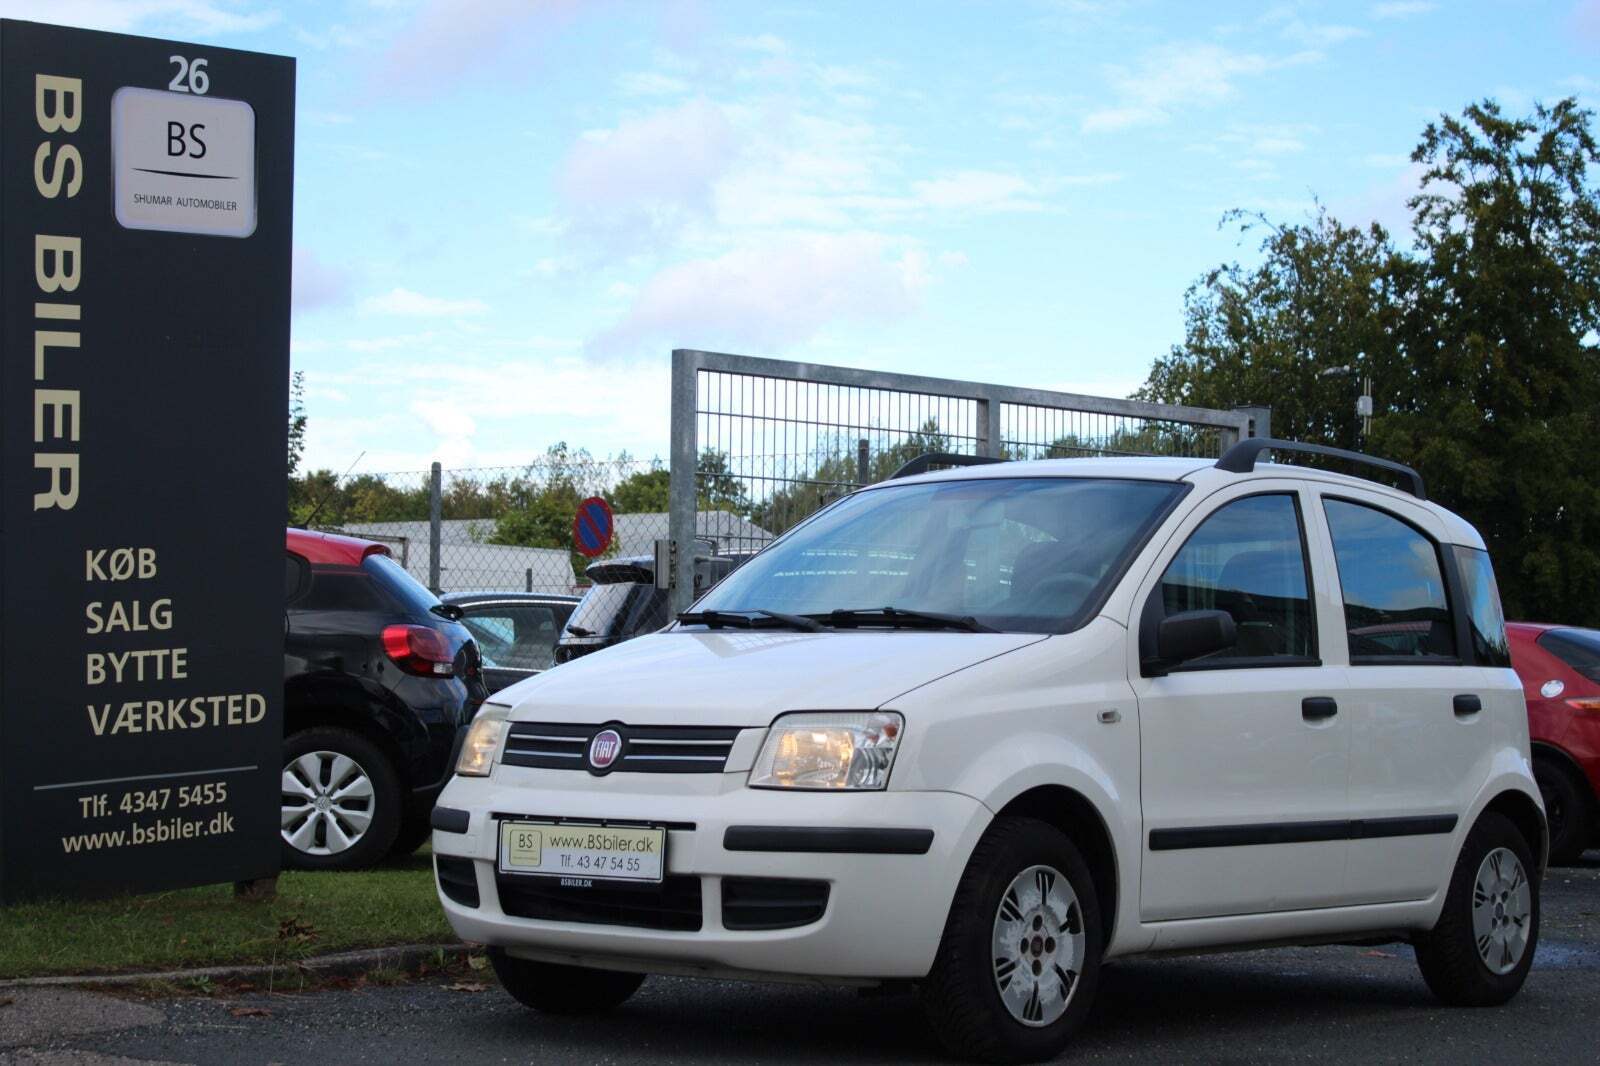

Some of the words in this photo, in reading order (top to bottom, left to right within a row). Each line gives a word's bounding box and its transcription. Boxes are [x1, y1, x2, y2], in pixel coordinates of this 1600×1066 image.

[168, 55, 210, 95] 26
[34, 73, 83, 200] BS
[167, 121, 207, 159] BS
[133, 193, 173, 206] SHUMAR
[176, 195, 238, 212] AUTOMOBILER
[33, 233, 82, 512] BILER
[86, 547, 157, 582] KØB
[86, 598, 174, 635] SALG
[87, 647, 188, 685] BYTTE
[87, 693, 267, 736] VÆRKSTED
[595, 739, 616, 758] FIAT
[78, 794, 113, 819] Tlf.
[119, 788, 171, 815] 4347
[178, 782, 228, 808] 5455
[62, 811, 235, 853] www.bsbiler.dk
[518, 833, 533, 849] BS
[550, 834, 654, 853] www.BSbiler.dk
[560, 854, 574, 868] Tlf.
[577, 856, 590, 869] 43
[594, 857, 607, 870] 47
[610, 858, 623, 871] 54
[627, 858, 640, 871] 55
[560, 878, 593, 888] BSBILER.DK
